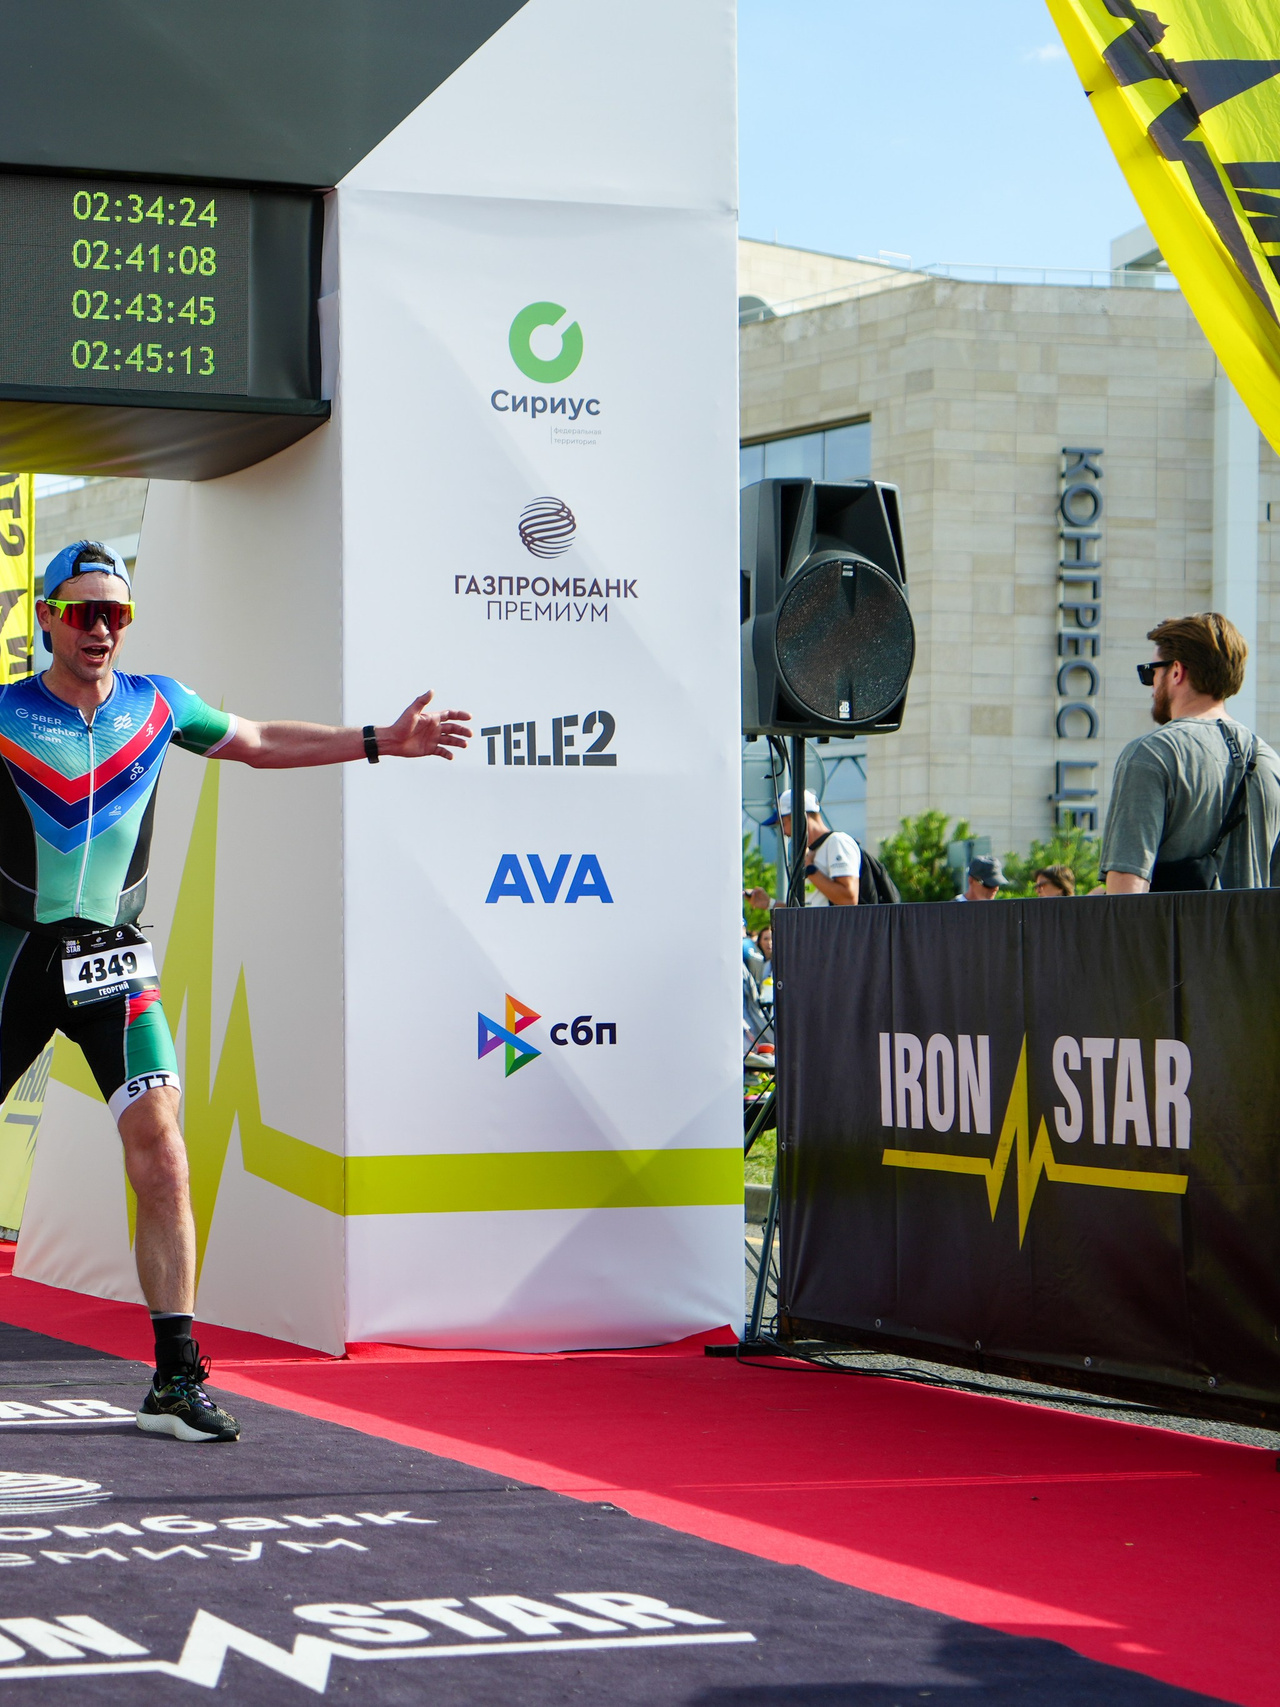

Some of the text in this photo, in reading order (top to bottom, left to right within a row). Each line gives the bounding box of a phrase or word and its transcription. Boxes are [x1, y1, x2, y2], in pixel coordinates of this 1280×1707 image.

[72, 190, 218, 229] 02:34:24
[72, 238, 218, 277] 02:41:08
[72, 289, 217, 327] 02:43:45
[72, 338, 216, 377] 02:45:13
[490, 389, 602, 421] Сириус
[454, 574, 639, 599] ГАЗПРОМБАНК
[1056, 446, 1104, 739] КОНГРЕСС
[486, 600, 609, 623] ПРЕМИУМ
[31, 713, 63, 726] SBER
[31, 722, 84, 738] Triathlon
[31, 731, 63, 744] Team
[480, 710, 618, 767] TELE2
[484, 853, 615, 904] AVA
[65, 945, 81, 954] STAR
[78, 951, 138, 984] 4349
[98, 981, 130, 997] ГЕОРГИЙ
[550, 1015, 618, 1046] сбп
[126, 1073, 170, 1099] STT
[878, 1032, 1193, 1150] IRON STAR
[292, 1591, 727, 1645] STAR
